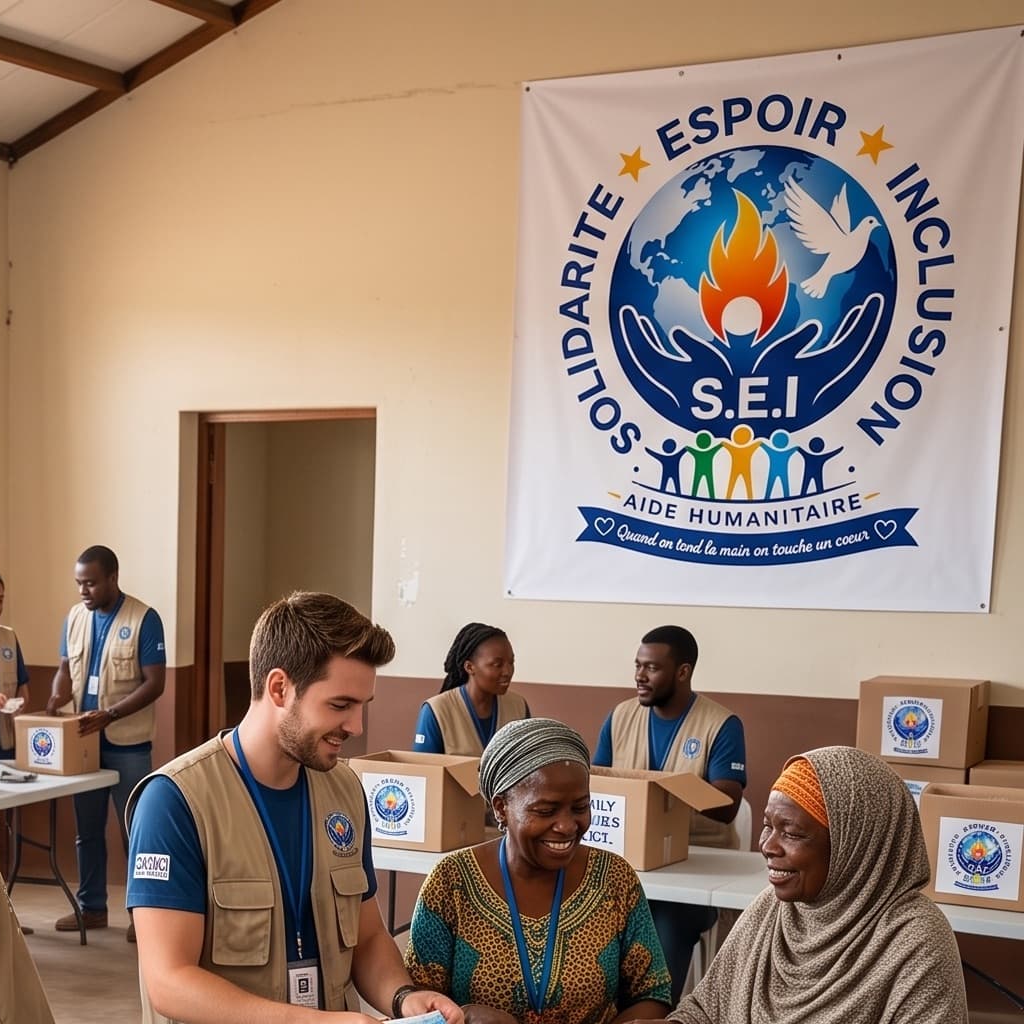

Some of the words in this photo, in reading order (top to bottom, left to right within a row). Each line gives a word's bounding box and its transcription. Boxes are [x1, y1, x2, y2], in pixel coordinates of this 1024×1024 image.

[656, 94, 847, 161] ESPOIR
[559, 183, 642, 455] SOLIDARITE
[856, 163, 955, 446] INCLUSION
[690, 376, 798, 420] S.E.I
[623, 494, 677, 519] AIDE
[689, 494, 862, 527] HUMANITAIRE
[617, 524, 657, 549] Quand
[659, 538, 674, 550] on
[704, 540, 718, 556] la
[719, 543, 751, 557] main
[753, 545, 770, 557] on
[772, 539, 813, 556] touche
[816, 536, 832, 550] un
[835, 531, 870, 547] coeur
